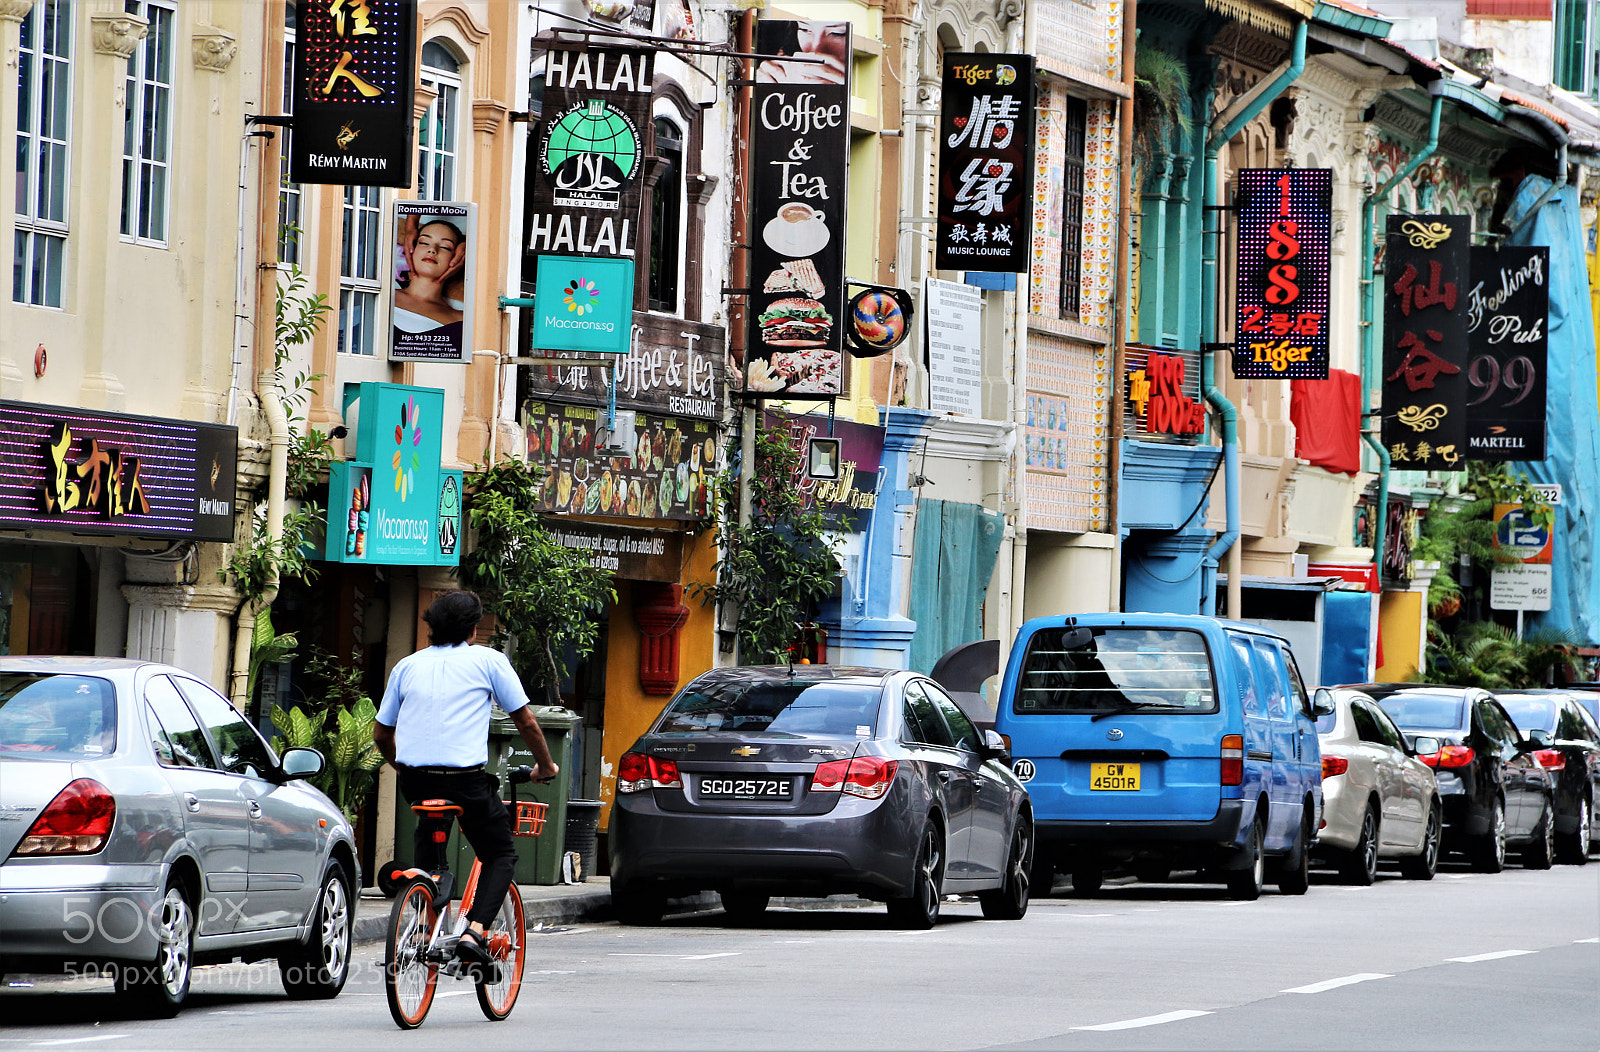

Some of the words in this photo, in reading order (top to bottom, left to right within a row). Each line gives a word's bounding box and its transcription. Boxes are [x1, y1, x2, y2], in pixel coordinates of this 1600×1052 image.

[545, 50, 653, 93] HALAL
[953, 64, 993, 86] Tiger
[761, 92, 842, 135] Coffee
[788, 138, 814, 161] &
[309, 153, 341, 168] RÉMY
[342, 155, 387, 170] MARTIN
[769, 160, 830, 200] Tea
[554, 199, 618, 209] SINGAPORE
[569, 191, 604, 200] HALAL
[398, 205, 438, 214] Romantic
[529, 213, 635, 256] HALAL
[948, 222, 1013, 246] 歌舞城
[947, 246, 975, 255] MUSIC
[976, 247, 1011, 256] LOUNGE
[1468, 254, 1544, 333] Feeling
[545, 316, 615, 332] Macarons.sg
[1241, 306, 1323, 336] 2号店
[1387, 260, 1460, 392] 仙谷
[1488, 315, 1543, 345] Pub
[665, 349, 684, 387] &
[680, 331, 717, 400] Tea
[1249, 340, 1313, 371] Tiger
[1467, 354, 1536, 408] 99
[670, 395, 716, 418] RESTAURANT
[1390, 441, 1459, 464] 歌舞吧
[1470, 437, 1526, 448] MARTELL
[212, 498, 230, 516] MARTIN
[376, 508, 429, 545] Macarons.sg
[591, 533, 603, 554] salt,
[603, 537, 619, 556] sugar,
[626, 536, 631, 553] &
[631, 540, 638, 553] no
[637, 537, 653, 554] added
[652, 538, 665, 555] MSG
[1017, 762, 1031, 775] 70
[1107, 764, 1125, 776] GW
[701, 779, 790, 796] SGQ2572E
[1094, 777, 1136, 789] 4501R
